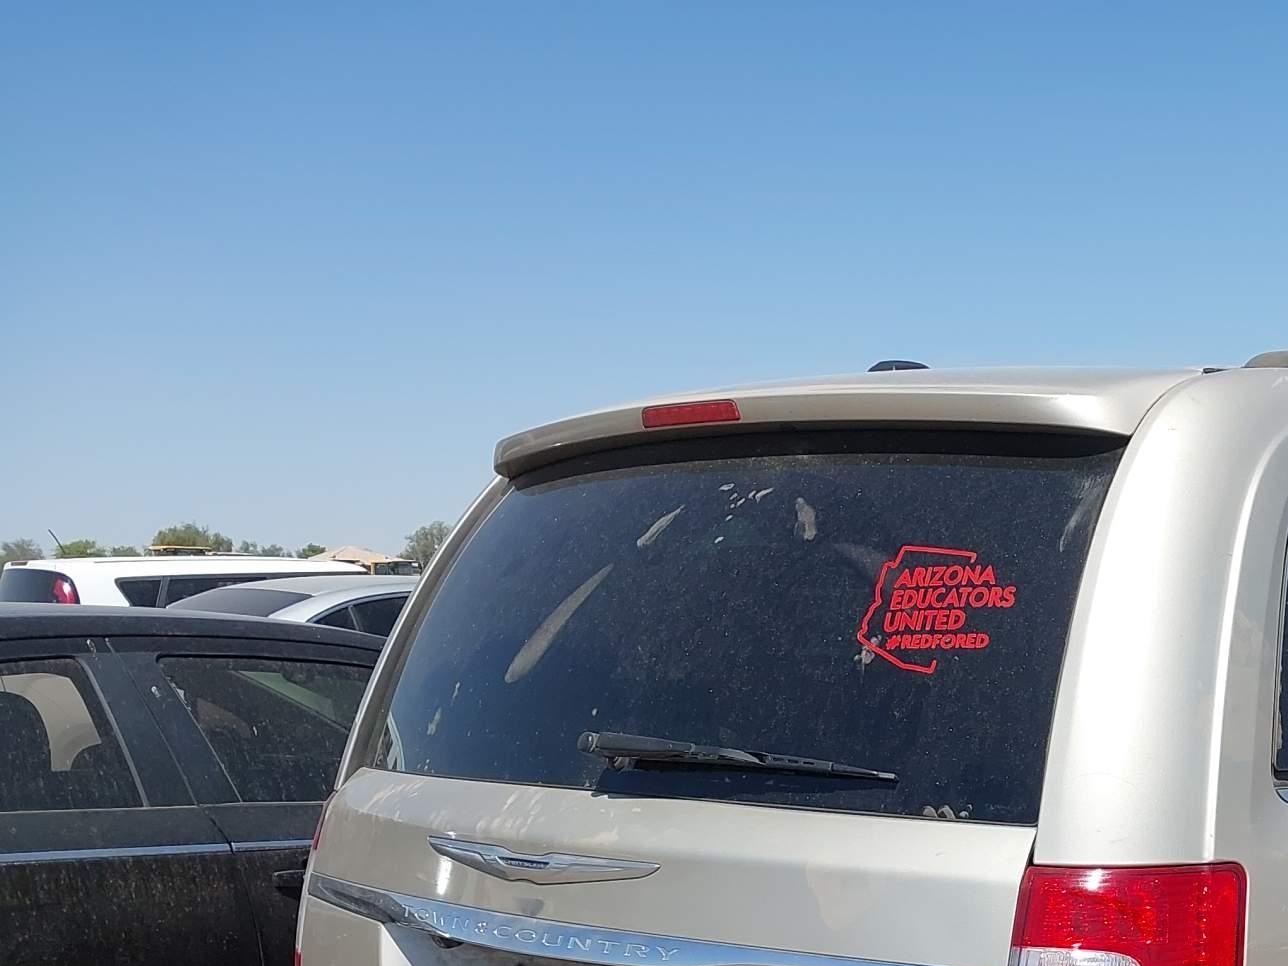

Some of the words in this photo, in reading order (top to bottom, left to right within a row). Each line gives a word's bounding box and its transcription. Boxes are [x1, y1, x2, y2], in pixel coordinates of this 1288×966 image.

[894, 565, 996, 588] ARIZONA
[890, 586, 1017, 610] EDUCATORS
[883, 609, 966, 632] UNITED
[886, 633, 990, 650] #REDFORED
